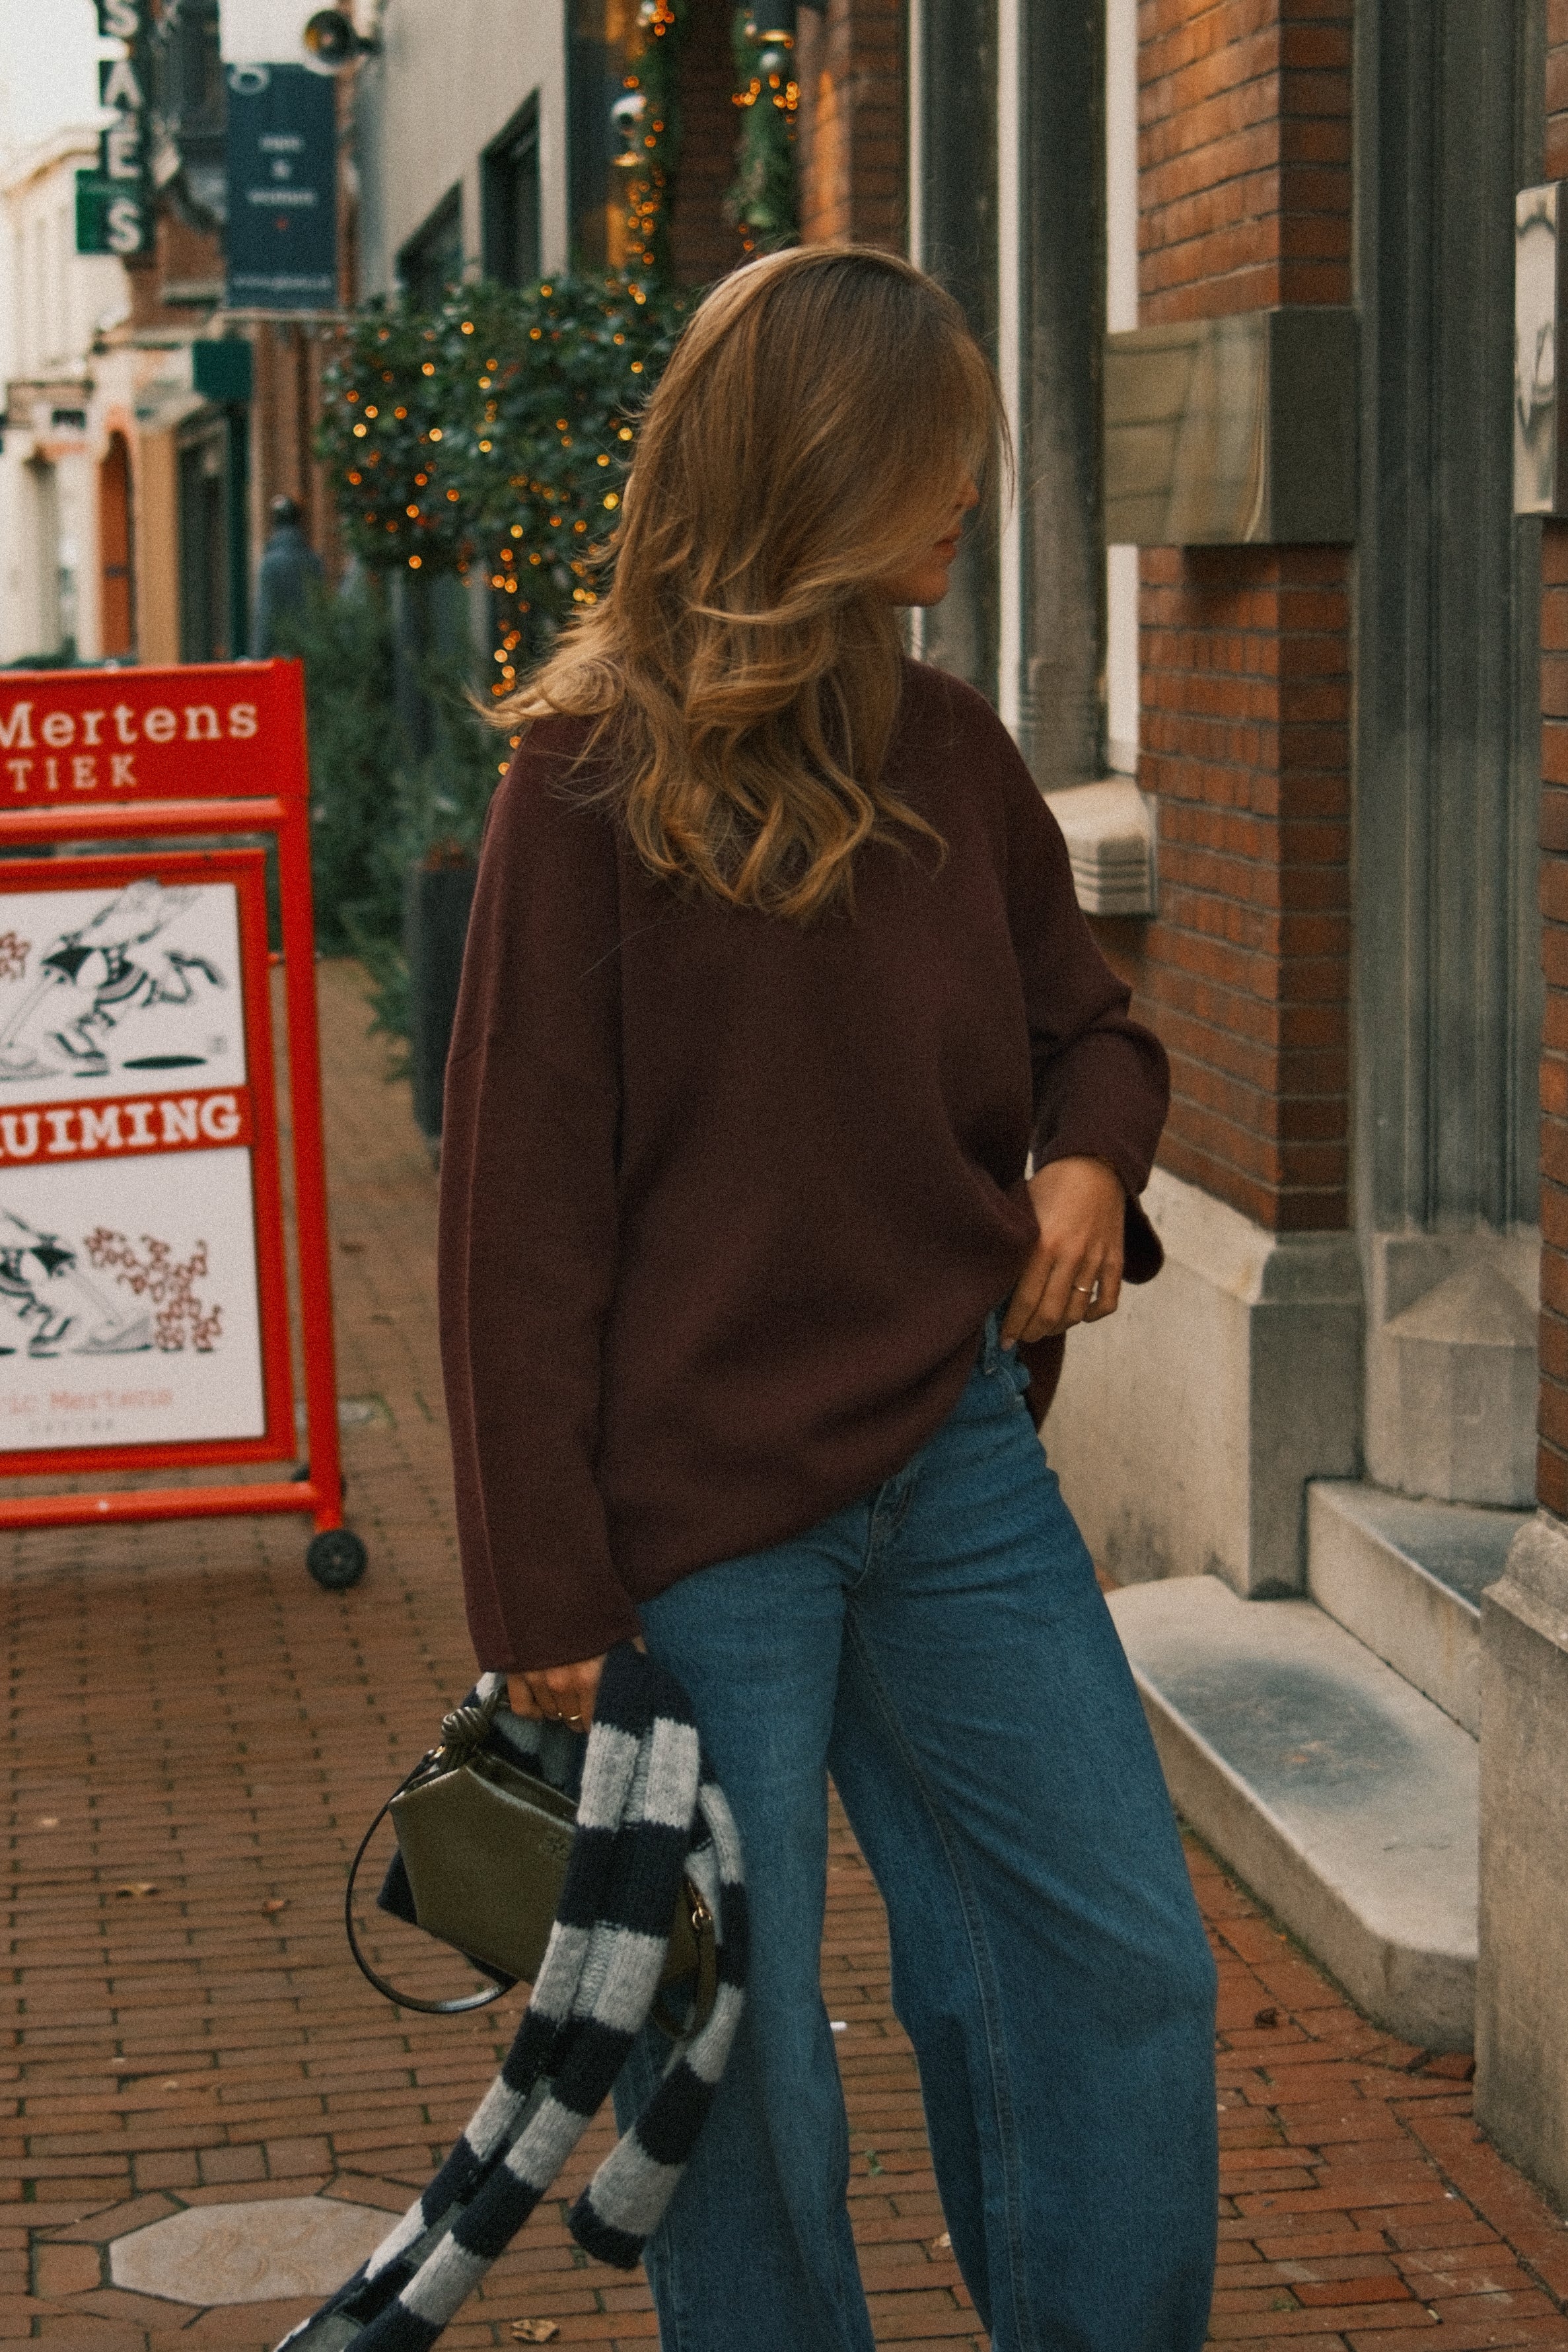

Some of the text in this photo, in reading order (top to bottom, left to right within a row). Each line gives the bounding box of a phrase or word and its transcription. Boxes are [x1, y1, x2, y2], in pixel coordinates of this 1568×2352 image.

[0, 701, 259, 748] Mertens
[7, 754, 137, 791] TIEK
[0, 1094, 240, 1157] UIMING
